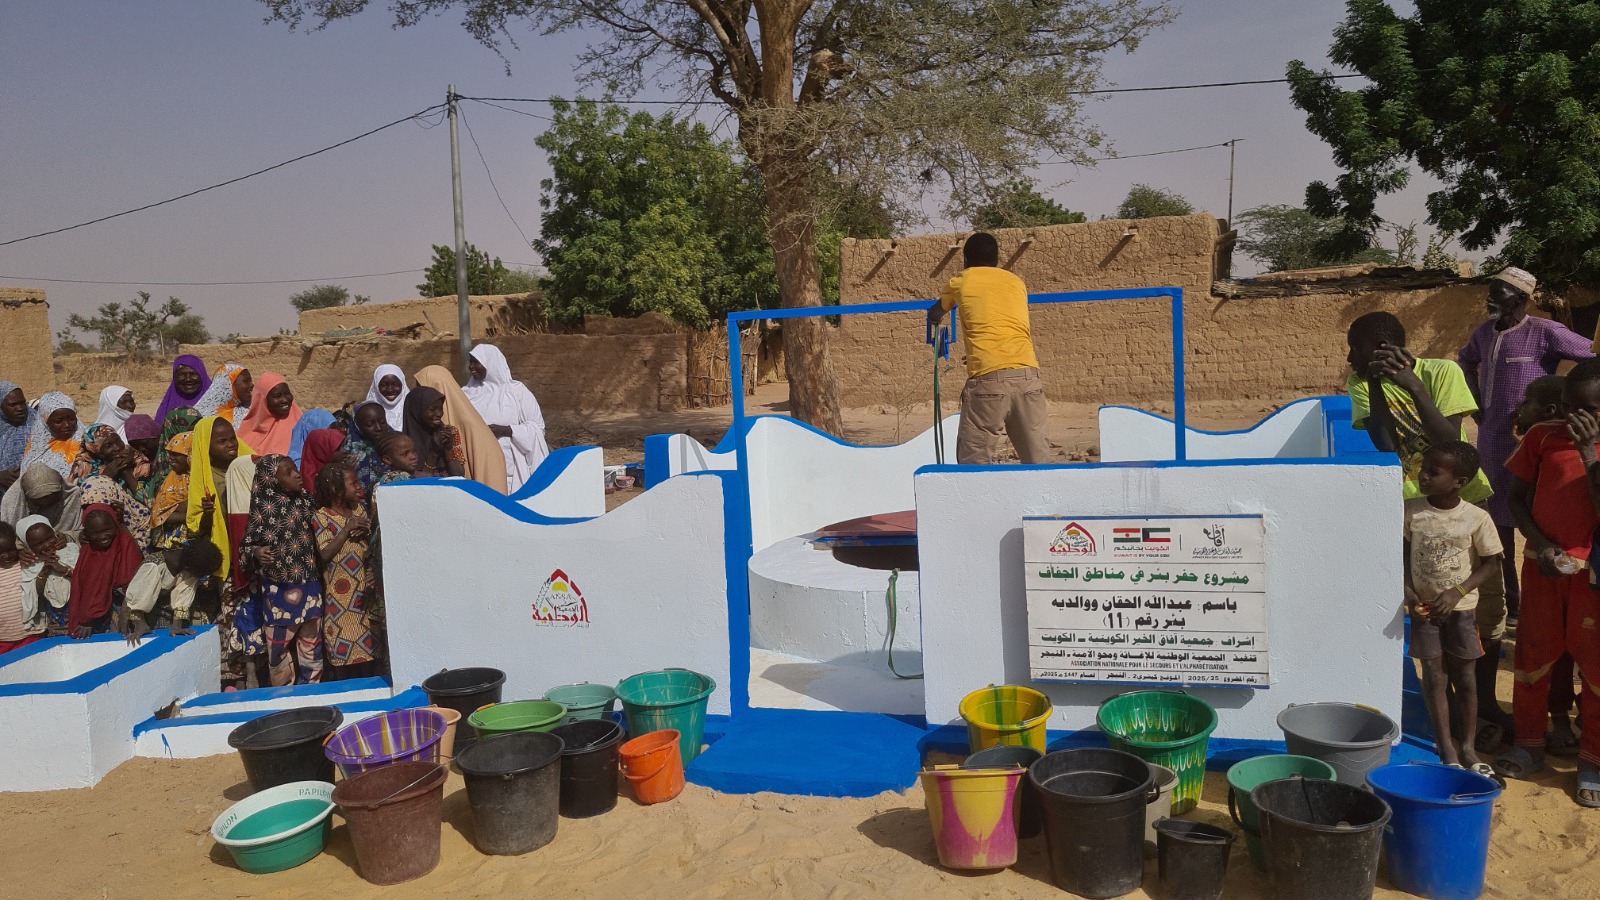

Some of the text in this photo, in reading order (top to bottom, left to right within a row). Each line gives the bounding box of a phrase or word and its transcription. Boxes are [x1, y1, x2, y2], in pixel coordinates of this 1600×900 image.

[1038, 566, 1250, 586] مشروع حفر بئر في مناطق الجفاف
[1051, 595, 1098, 611] ووالديه
[1102, 595, 1141, 611] الحقان
[1202, 597, 1237, 614] باسم
[531, 603, 590, 627] الوطنية
[1134, 612, 1159, 630] رقم
[1162, 613, 1185, 630] بئر
[1041, 632, 1076, 645] الكويت
[1088, 632, 1129, 645] الكويتية
[1131, 633, 1155, 646] الخير
[1158, 633, 1178, 646] آفاق
[1180, 634, 1214, 647] جمعية
[1040, 649, 1065, 659] النيجر
[1097, 651, 1118, 660] ومحو
[1156, 651, 1189, 662] الوطنية
[1191, 653, 1225, 663] الجمعية
[1232, 653, 1257, 664] تنفيذ
